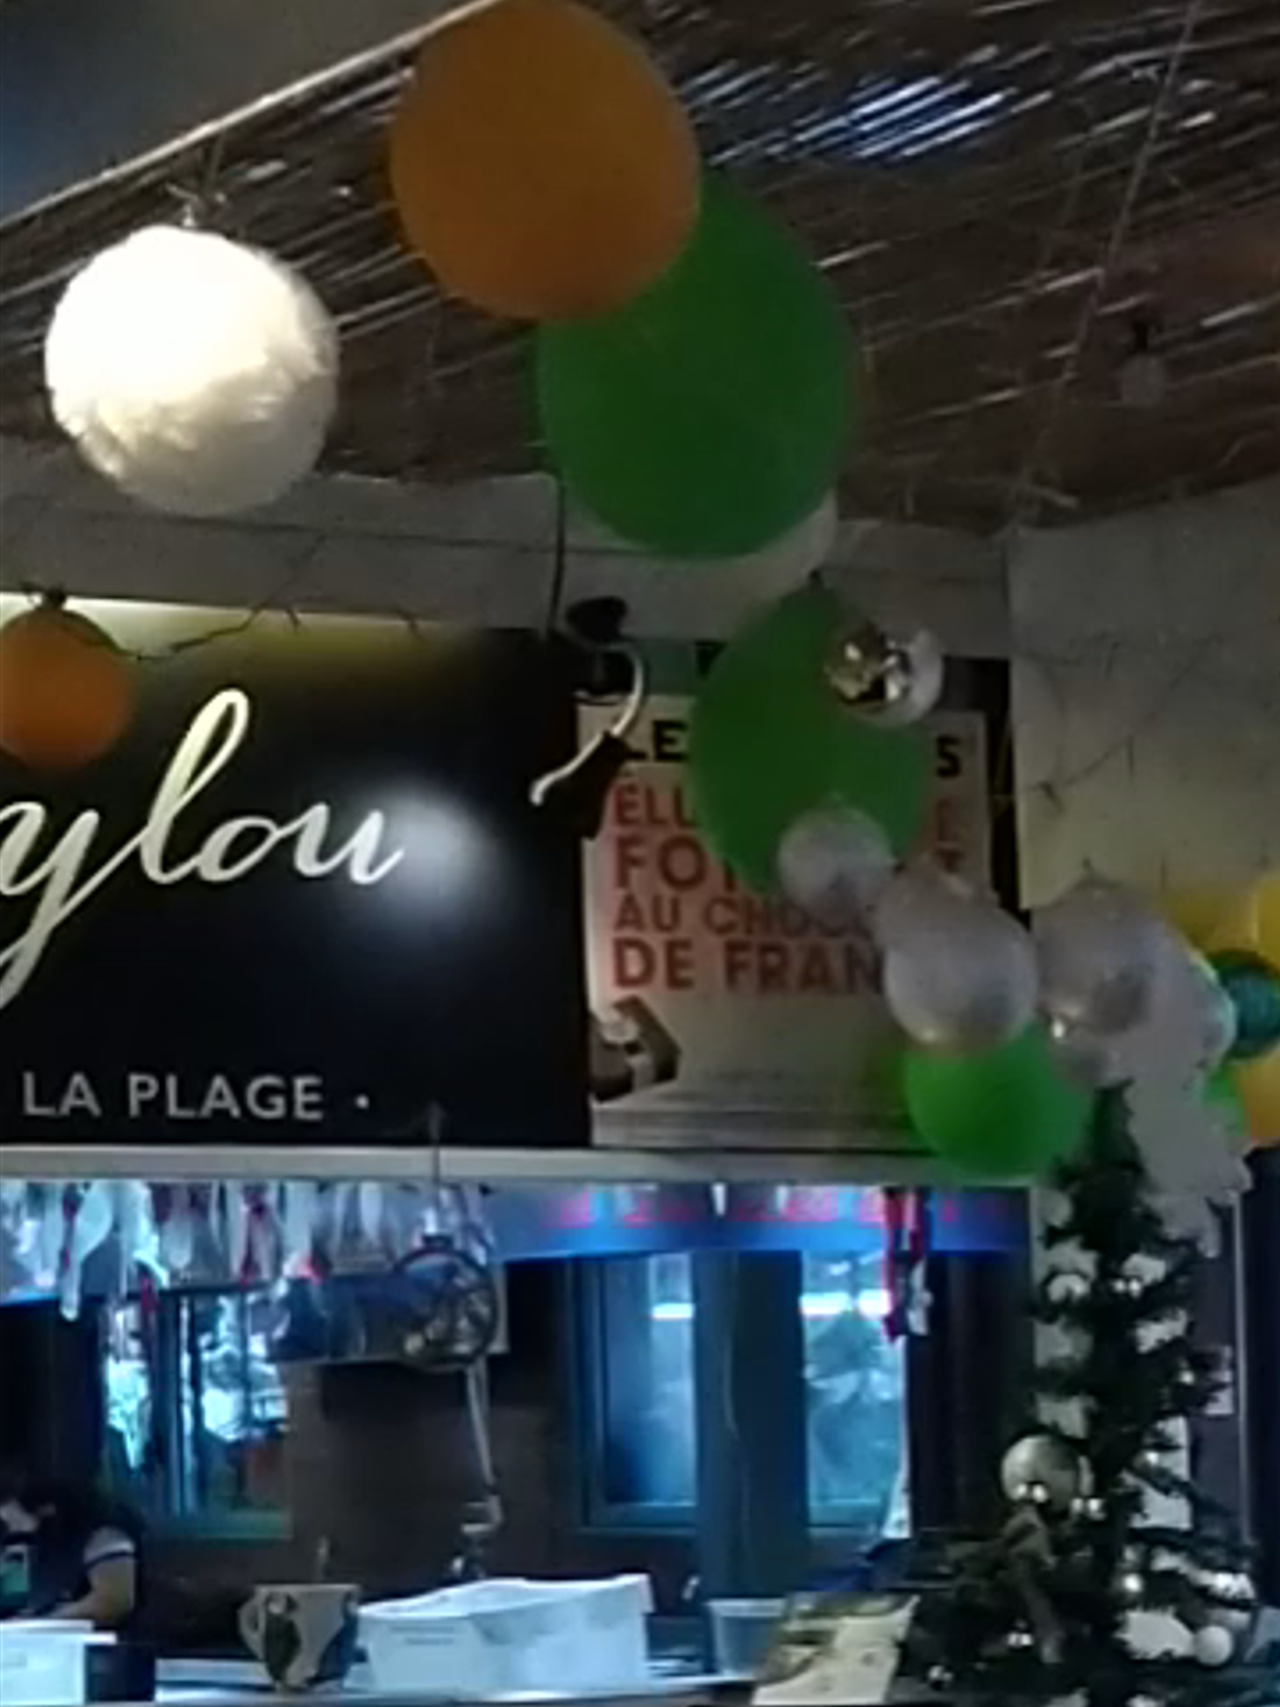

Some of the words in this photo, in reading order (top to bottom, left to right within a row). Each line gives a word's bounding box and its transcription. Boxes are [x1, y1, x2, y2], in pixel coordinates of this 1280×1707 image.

[614, 898, 681, 932] AU
[614, 938, 695, 989] DE
[726, 941, 882, 992] FRAN
[22, 1072, 101, 1117] LA
[127, 1074, 324, 1121] PLAGE
